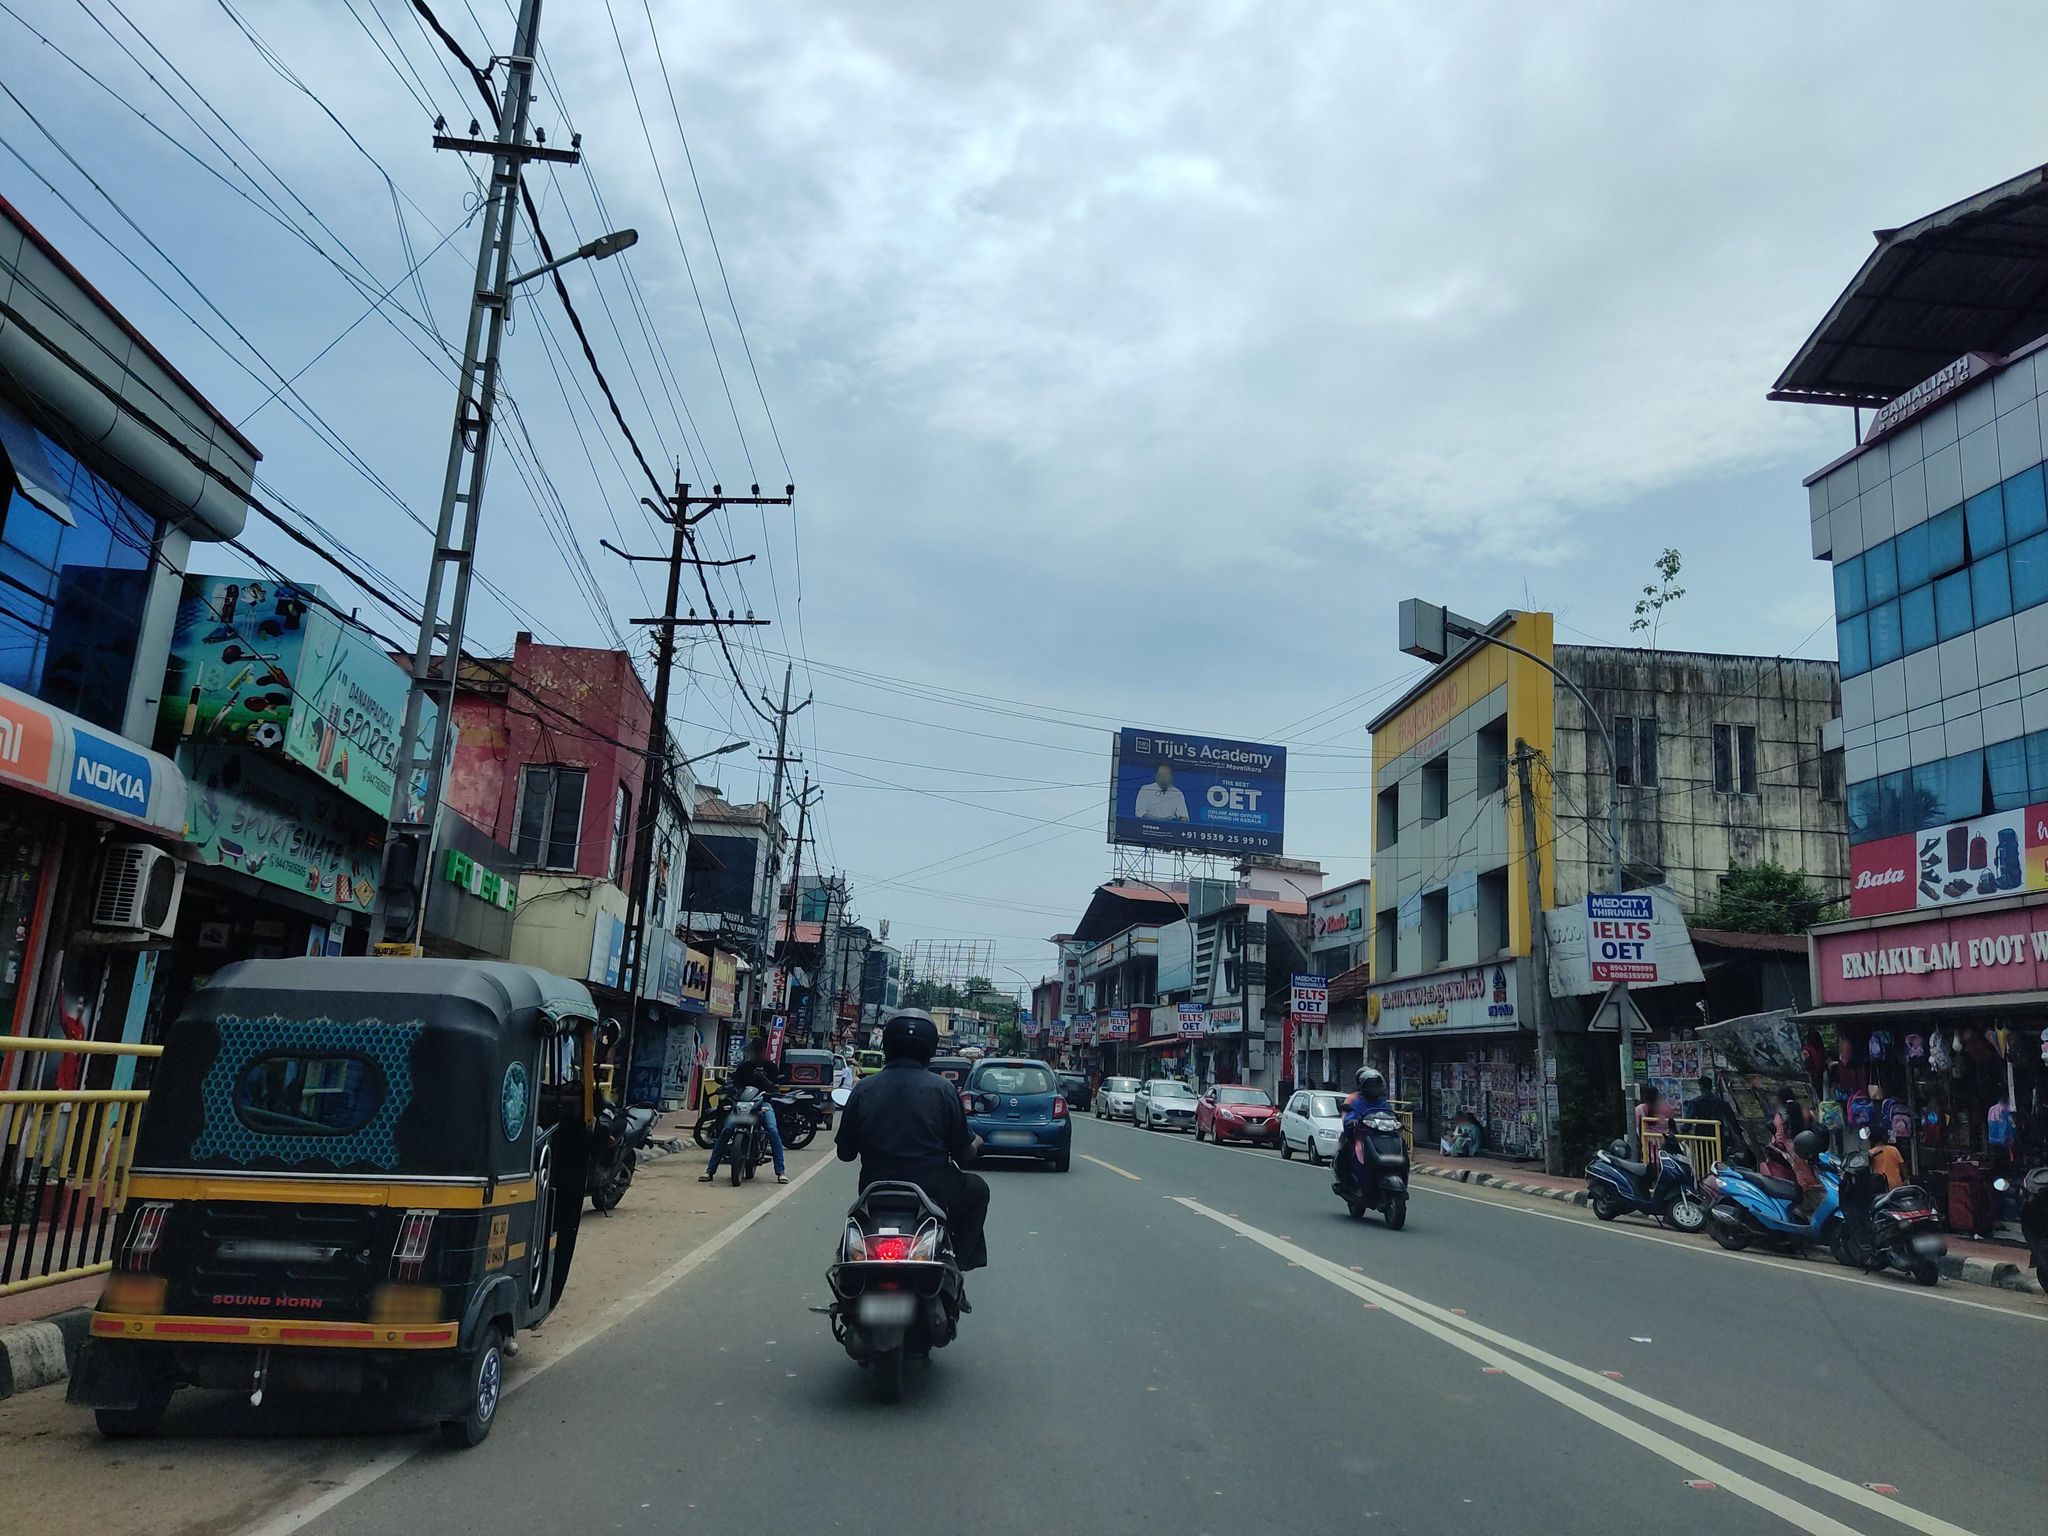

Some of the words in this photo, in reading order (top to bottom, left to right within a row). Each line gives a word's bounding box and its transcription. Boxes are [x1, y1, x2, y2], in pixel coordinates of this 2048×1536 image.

[1879, 355, 1970, 422] GAMALIATH
[1878, 371, 1970, 431] BUILDING
[1155, 739, 1197, 758] Tiju's
[1200, 744, 1273, 768] Academy
[76, 756, 145, 803] NOKIA
[1206, 785, 1262, 811] OET
[231, 803, 344, 874] SPORTSMATE
[1181, 831, 1197, 840] +91
[1200, 832, 1224, 842] 9539
[1228, 834, 1239, 843] 25
[1242, 836, 1255, 845] 99
[1258, 838, 1268, 846] 10
[1855, 866, 1905, 889] Bata
[1592, 897, 1649, 908] MEDCITY
[1591, 908, 1650, 918] THIRUVALLA
[1593, 921, 1652, 940] IELTS
[1601, 941, 1645, 960] OET
[1842, 940, 1962, 979] ERNAKULAM
[1968, 934, 2026, 968] FOOT
[1294, 975, 1326, 983] MEDCITY
[1294, 989, 1326, 1000] IELTS
[1297, 1001, 1322, 1012] OET
[1179, 1014, 1203, 1022] IELTS
[1182, 1022, 1200, 1030] OET
[211, 1295, 271, 1307] SOUND
[275, 1296, 323, 1308] HORN
